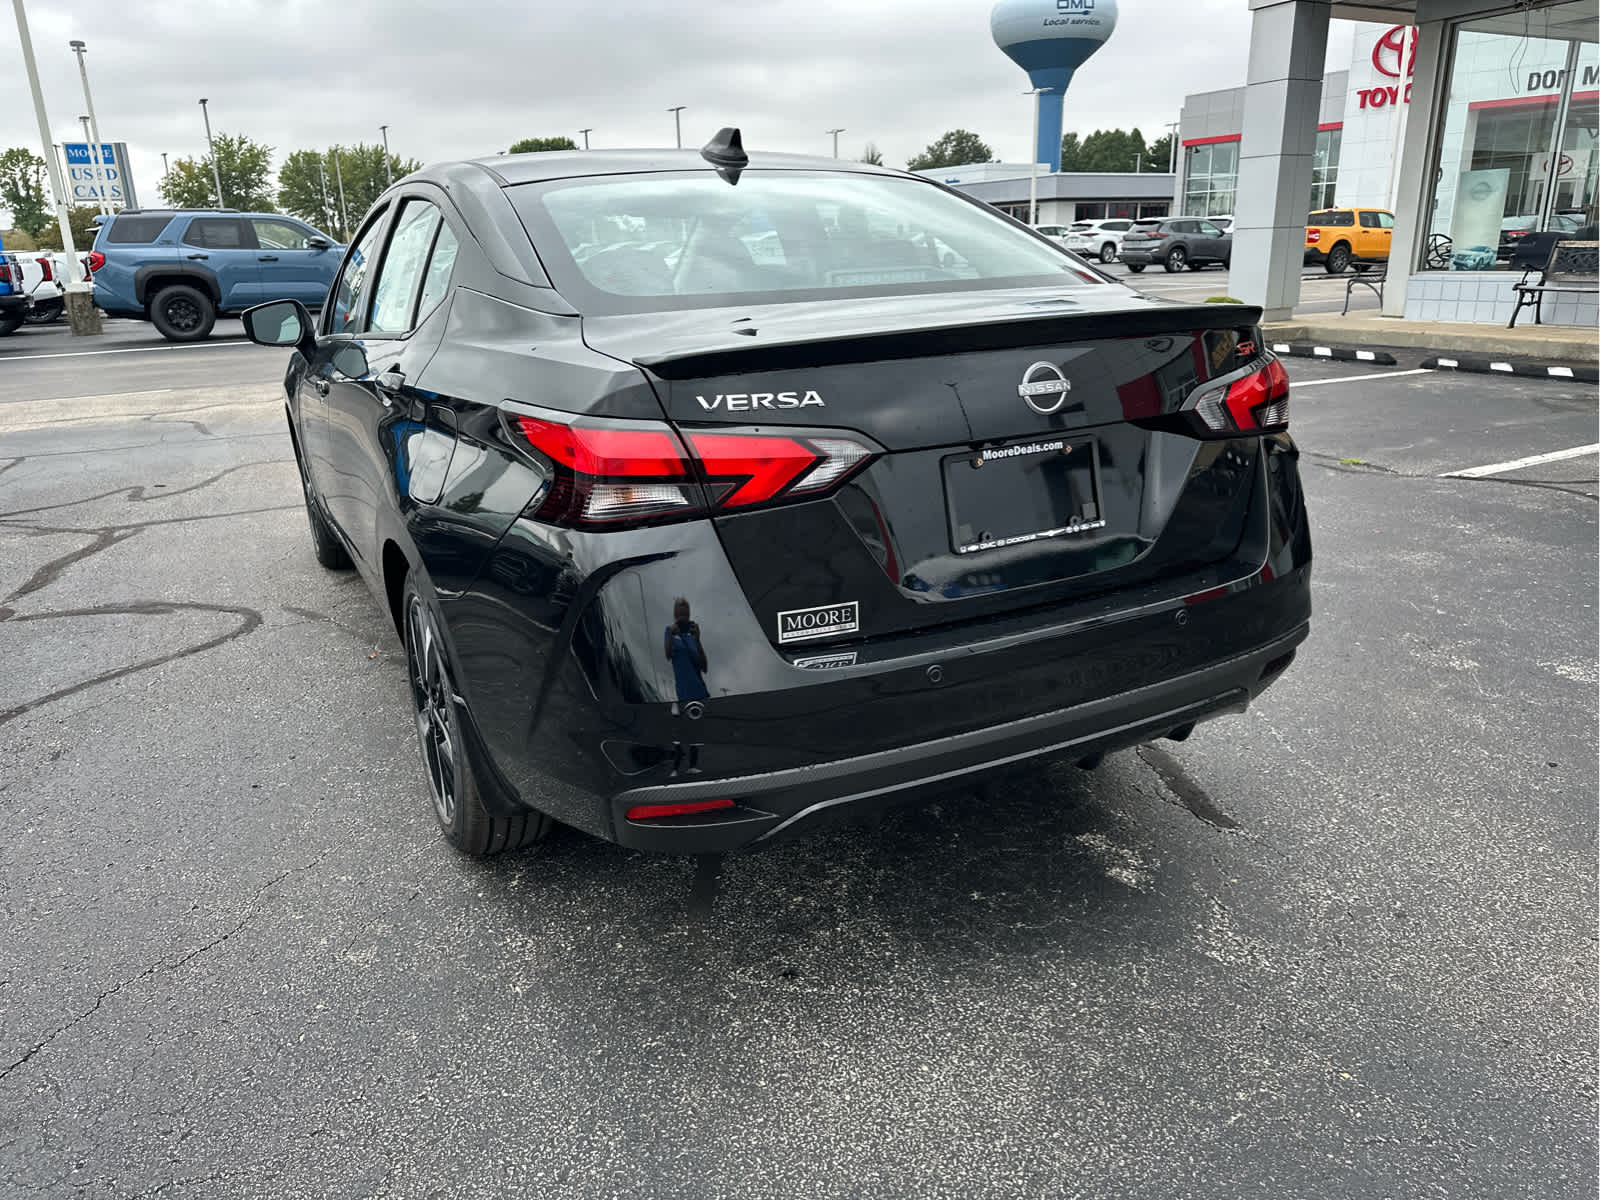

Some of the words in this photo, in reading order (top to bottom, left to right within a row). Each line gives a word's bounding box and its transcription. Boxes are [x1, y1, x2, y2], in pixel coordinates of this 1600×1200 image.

[1043, 17, 1070, 26] Local
[68, 149, 113, 158] MOE
[1236, 341, 1256, 356] SR
[1020, 381, 1071, 394] NISSAN
[695, 390, 826, 411] VERSA
[983, 441, 1064, 460] MooreDeals.com
[786, 608, 852, 630] MOORE
